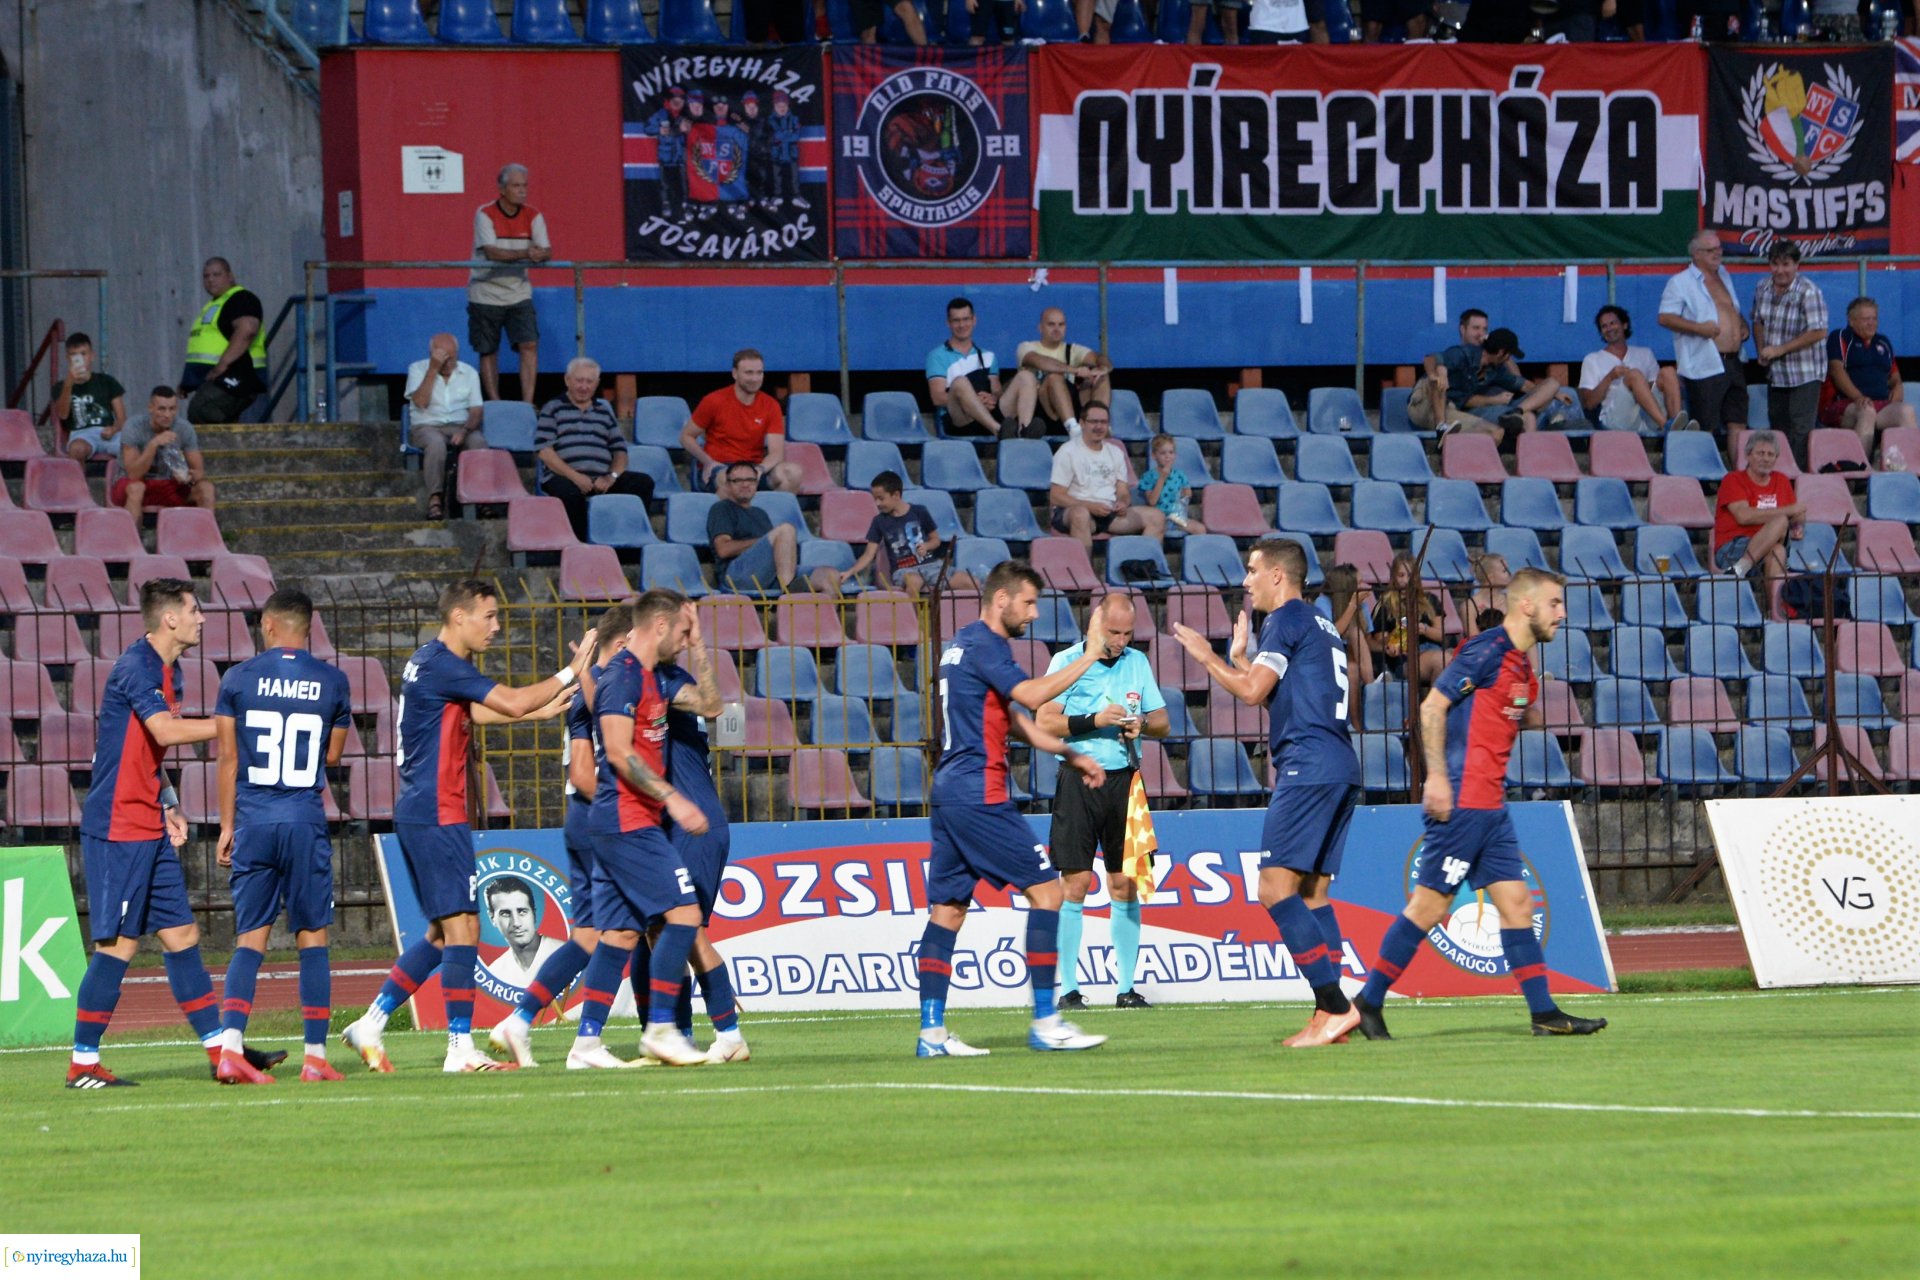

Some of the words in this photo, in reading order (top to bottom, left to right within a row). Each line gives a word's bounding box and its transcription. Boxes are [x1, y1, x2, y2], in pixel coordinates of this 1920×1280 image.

[632, 56, 816, 103] NYÍREGYHÁZA
[870, 75, 914, 112] OLD
[924, 71, 983, 113] FANS
[1805, 91, 1830, 118] NY
[1832, 105, 1849, 128] S
[842, 135, 870, 157] 19
[985, 134, 1021, 157] 28
[1074, 63, 1662, 214] NYÍREGYHÁZA
[1804, 127, 1820, 144] F
[1820, 133, 1837, 153] C
[877, 185, 982, 222] SPARTACUS
[1712, 180, 1886, 230] MASTIFFS
[639, 213, 816, 260] JÓSAVÁROS
[257, 677, 322, 701] HAMED
[1331, 647, 1349, 720] 5
[245, 710, 323, 787] 30
[724, 717, 738, 733] 10
[713, 859, 985, 920] OZSI
[1821, 877, 1875, 910] VG
[691, 937, 1031, 998] BDARÚGÓ
[1053, 930, 1368, 986] KADÉMA
[1428, 927, 1498, 974] BDARÚGÓ
